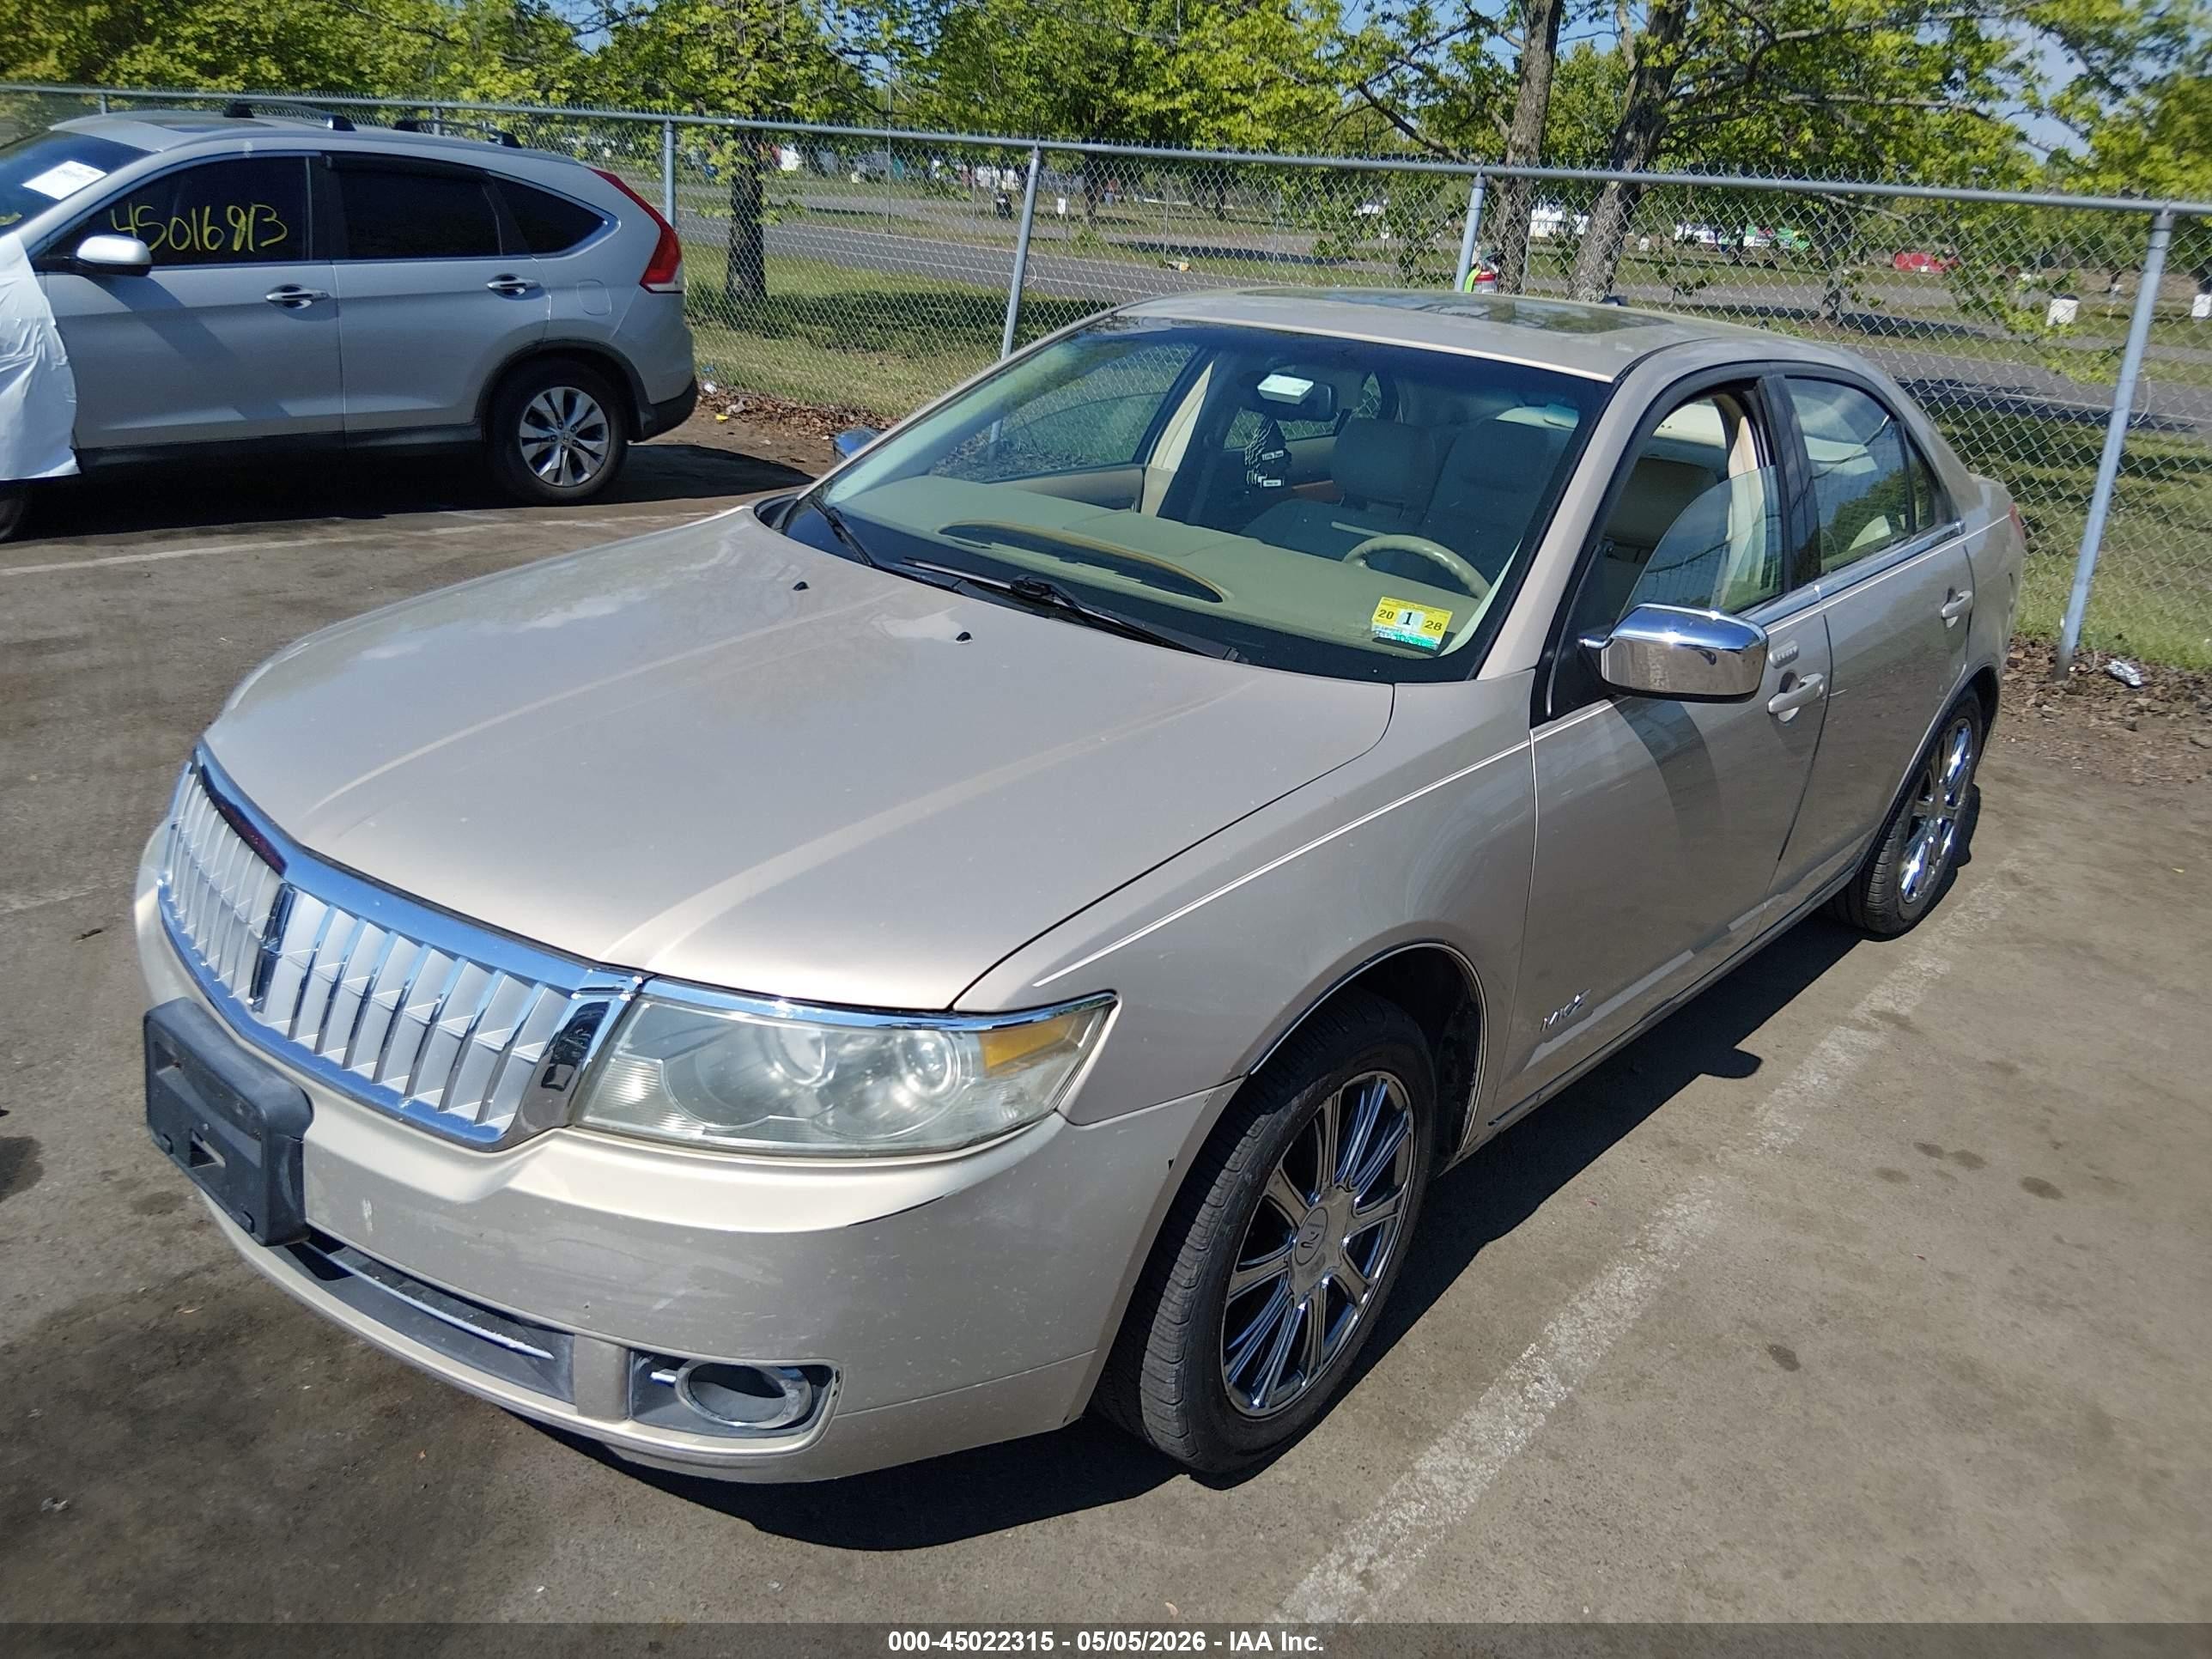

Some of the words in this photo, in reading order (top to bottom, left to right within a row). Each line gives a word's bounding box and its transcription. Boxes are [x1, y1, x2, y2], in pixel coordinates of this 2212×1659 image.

[1378, 609, 1395, 620] 20
[1402, 611, 1413, 626] 1
[1425, 620, 1443, 631] 28
